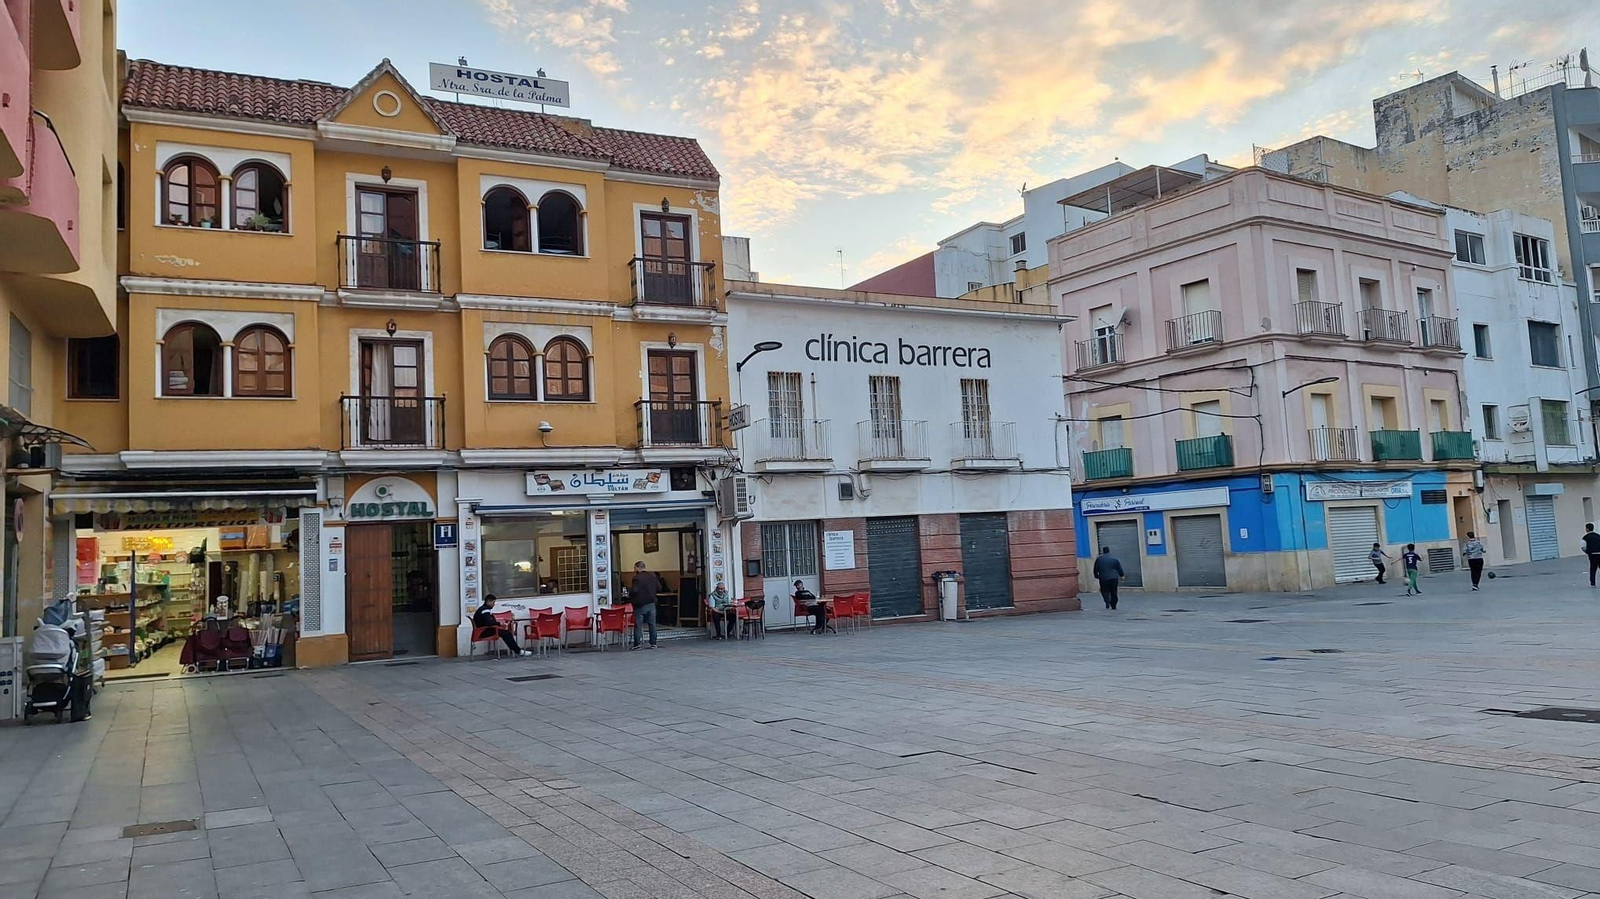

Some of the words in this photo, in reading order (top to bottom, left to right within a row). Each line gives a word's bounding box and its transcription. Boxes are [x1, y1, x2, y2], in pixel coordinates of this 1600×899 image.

[457, 69, 545, 89] HOSTAL
[438, 78, 469, 92] Ntra.
[472, 82, 494, 95] Sra.
[497, 86, 510, 96] de
[513, 88, 524, 98] la
[528, 90, 562, 104] Palma
[805, 333, 889, 364] clínica
[898, 337, 991, 368] barrera
[570, 472, 629, 488] سلطان
[351, 501, 434, 518] HOSTAL
[124, 519, 259, 531] MULTIPRECIOS
[1408, 556, 1413, 564] 5
